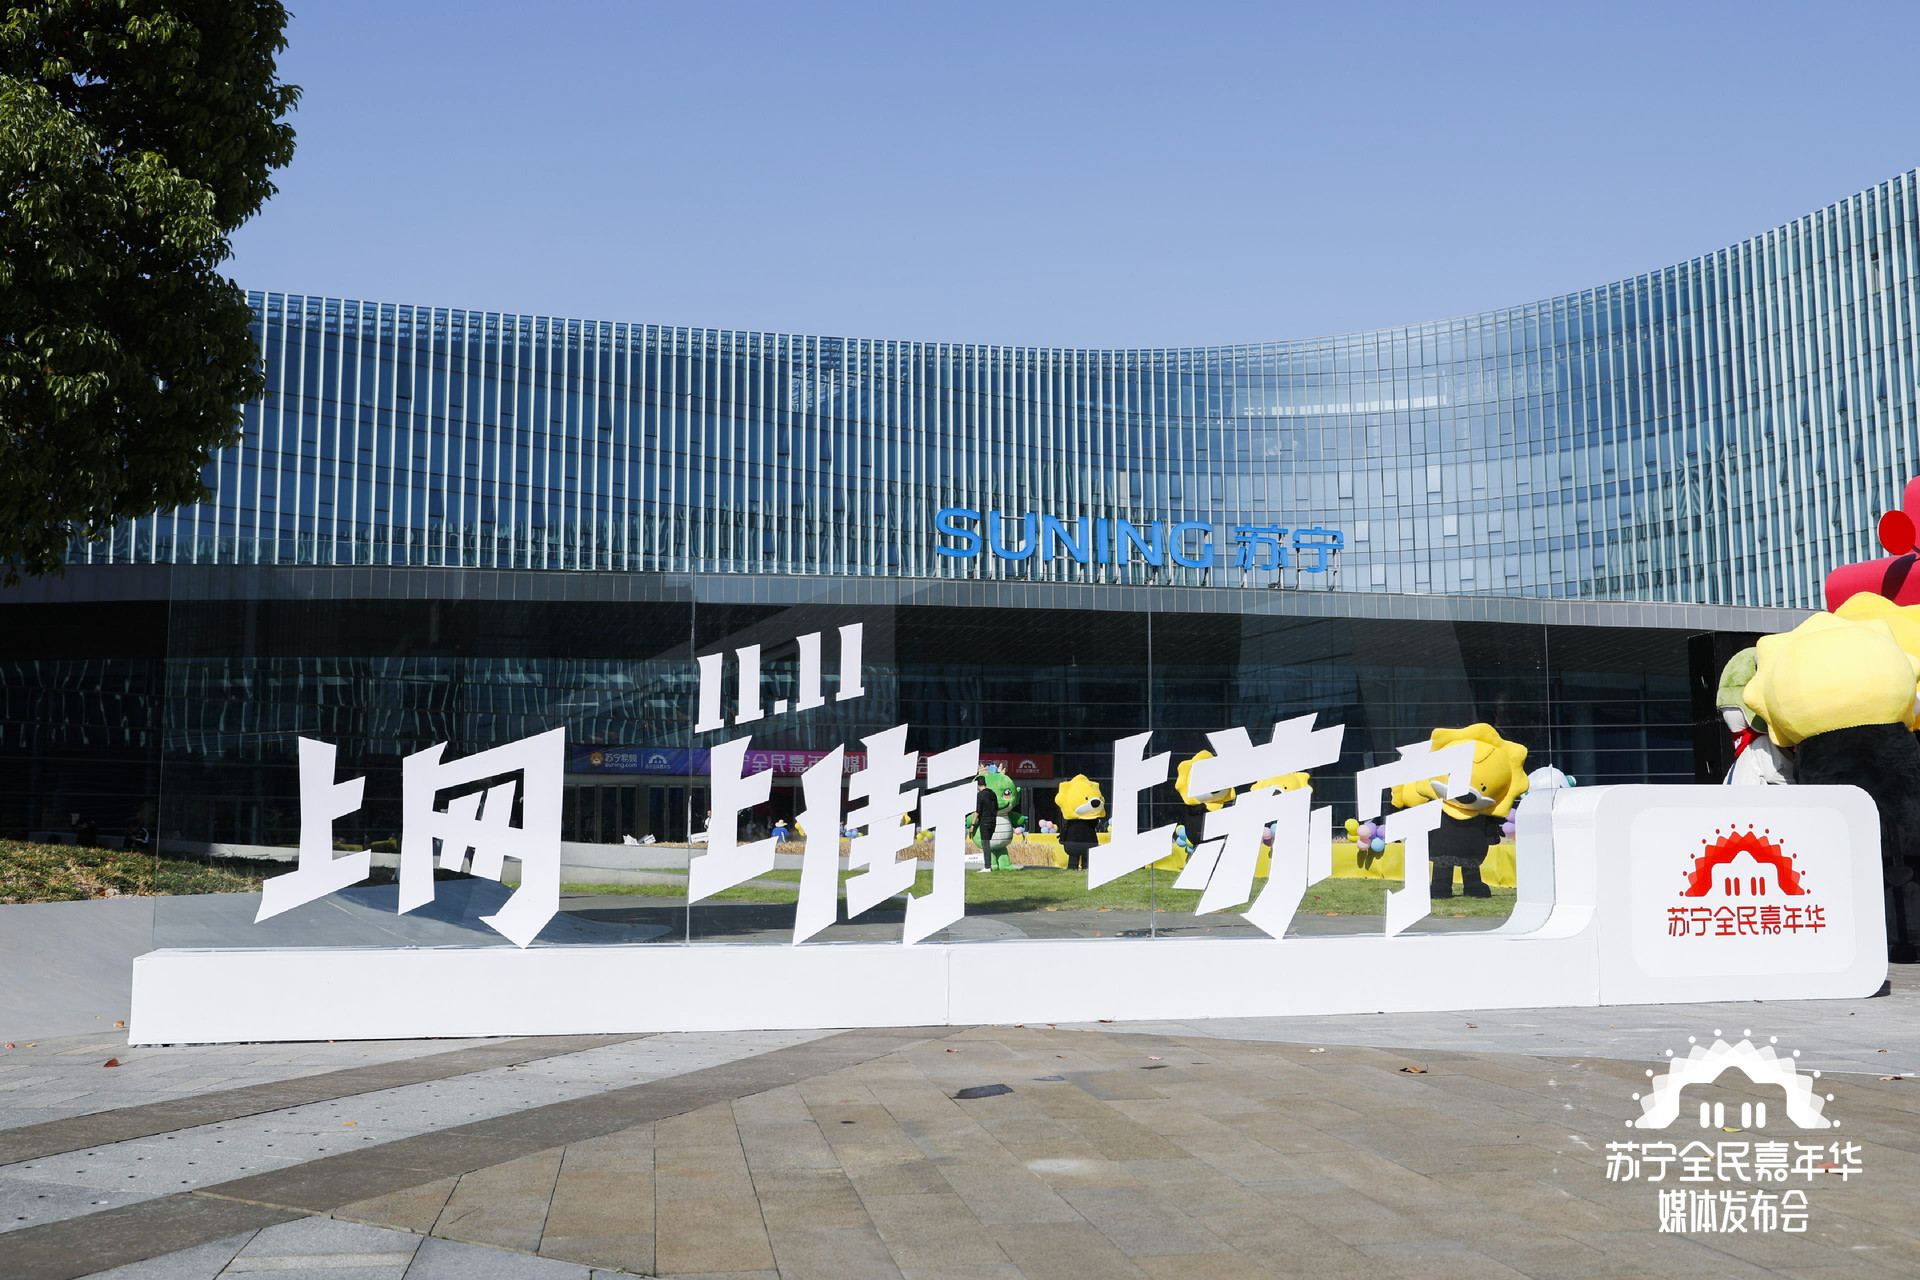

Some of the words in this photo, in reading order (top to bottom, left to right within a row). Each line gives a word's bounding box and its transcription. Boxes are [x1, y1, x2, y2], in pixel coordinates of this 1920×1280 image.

[936, 507, 1213, 568] SUNING
[1234, 524, 1345, 573] 苏宁
[695, 623, 865, 733] 11.11
[254, 727, 566, 948] 上网
[689, 723, 981, 945] 上街
[1087, 713, 1476, 940] 上苏宁
[1667, 904, 1826, 936] 苏宁全民嘉年华
